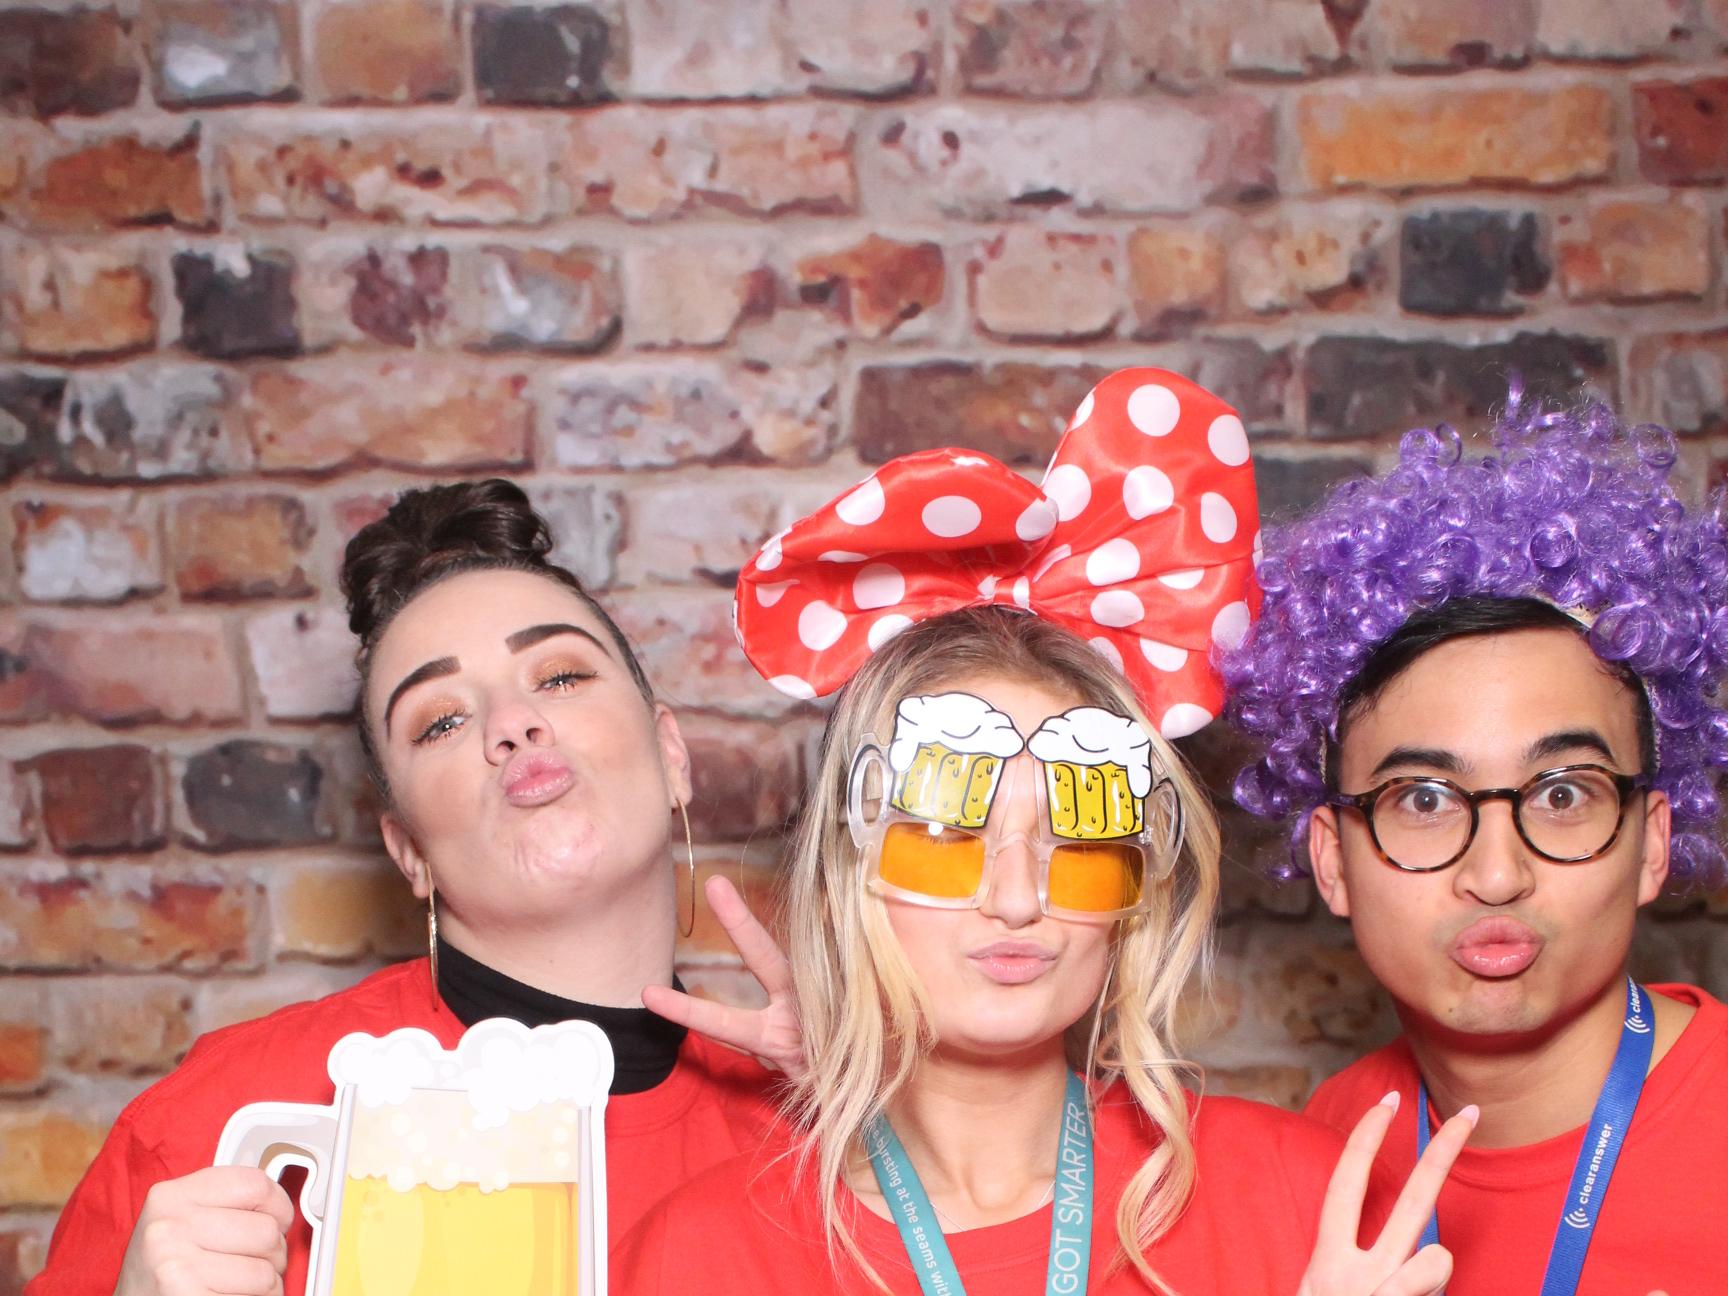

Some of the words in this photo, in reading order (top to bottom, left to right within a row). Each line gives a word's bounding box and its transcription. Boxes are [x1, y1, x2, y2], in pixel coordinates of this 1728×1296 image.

[875, 1136, 903, 1188] bursting
[1058, 1101, 1088, 1226] SMARTER
[1578, 1123, 1614, 1206] clearanswer
[896, 1187, 911, 1201] at
[903, 1201, 919, 1224] the
[913, 1226, 938, 1269] seams
[1052, 1233, 1080, 1296] GOT
